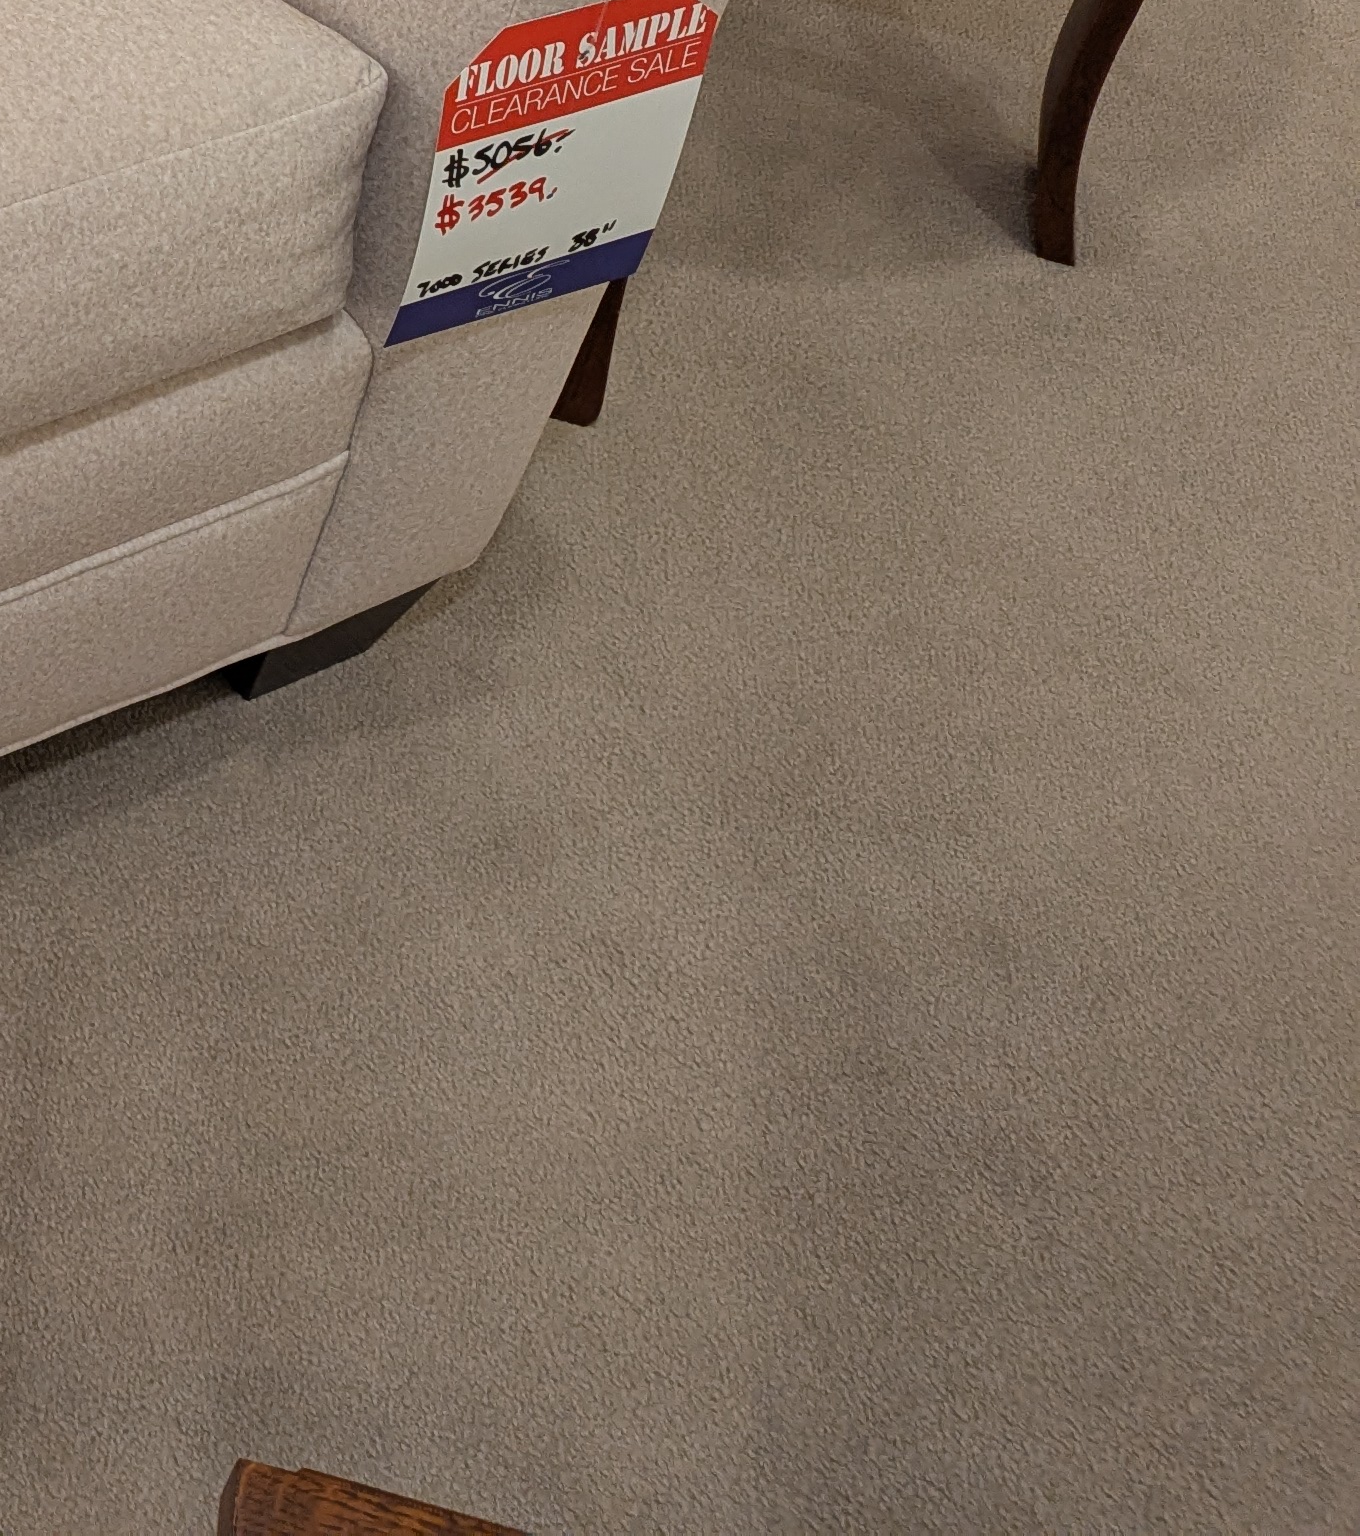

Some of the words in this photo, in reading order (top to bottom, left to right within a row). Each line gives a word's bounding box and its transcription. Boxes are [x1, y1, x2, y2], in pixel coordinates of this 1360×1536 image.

[451, 64, 621, 135] CLEARANCE
[627, 41, 701, 83] SALE
[454, 41, 566, 102] FLOOR
[576, 2, 708, 69] SAMPLE
[471, 246, 550, 283] SERIES
